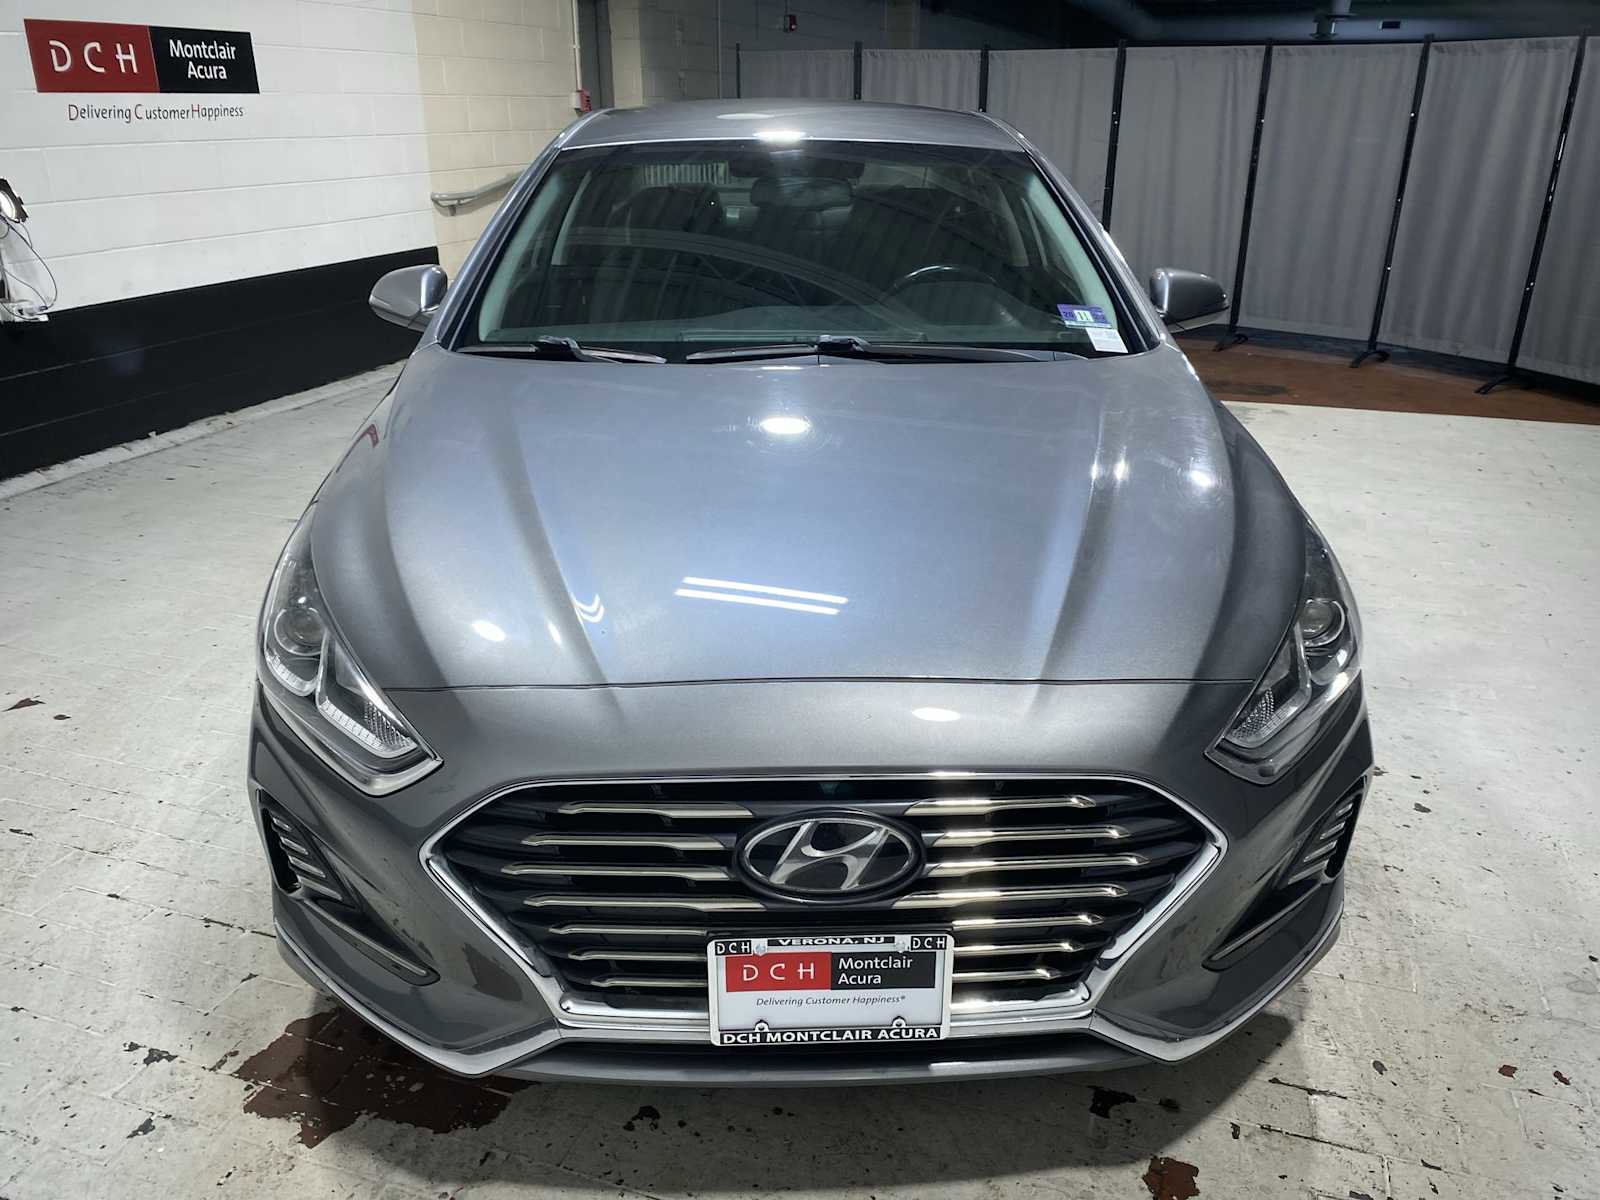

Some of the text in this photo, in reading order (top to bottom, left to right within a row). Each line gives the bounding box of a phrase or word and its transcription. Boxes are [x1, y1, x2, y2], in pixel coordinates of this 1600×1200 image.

[48, 39, 139, 74] DCH
[169, 38, 236, 60] Montclair
[187, 60, 227, 80] Acura
[68, 103, 131, 124] Delivering
[191, 103, 244, 121] Happiness
[716, 941, 751, 955] DCH
[912, 937, 946, 949] DCH
[838, 956, 913, 970] Montclair
[743, 962, 815, 981] DCH
[837, 972, 882, 985] Acura
[756, 997, 804, 1007] Delivering
[805, 995, 851, 1005] Customer
[723, 1028, 939, 1044] DCH MONTCLAIR ACURA
